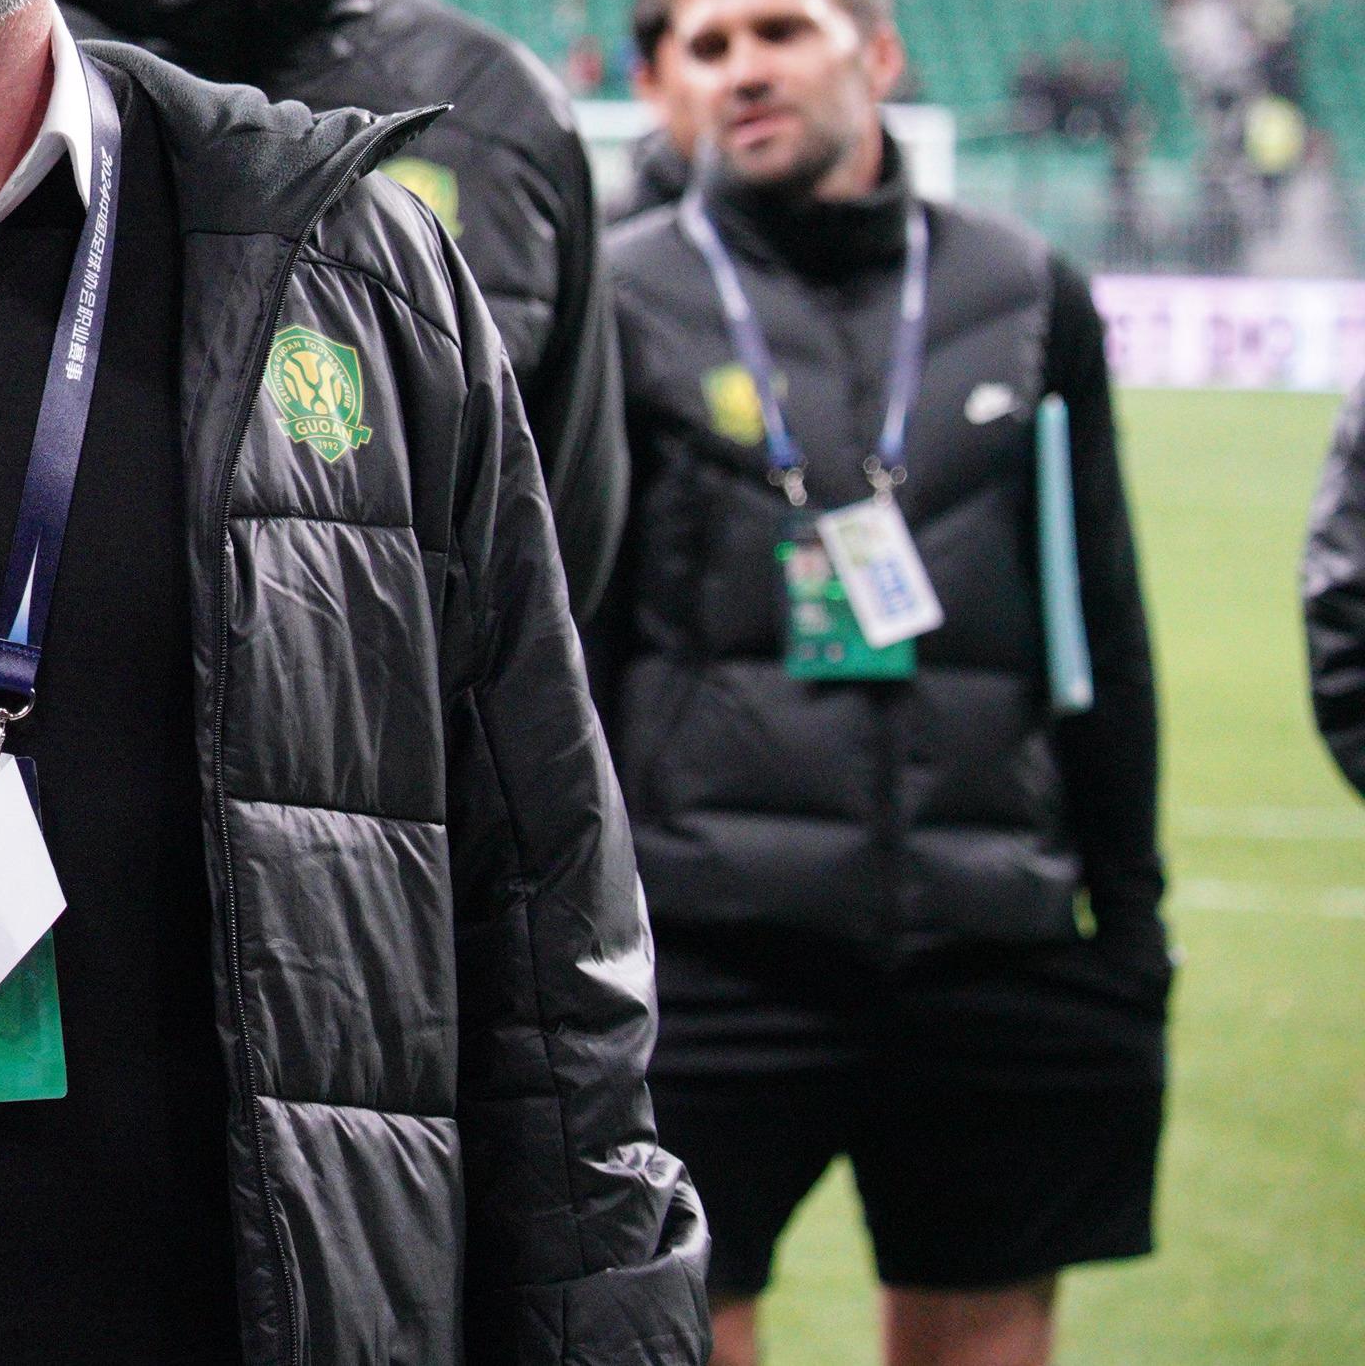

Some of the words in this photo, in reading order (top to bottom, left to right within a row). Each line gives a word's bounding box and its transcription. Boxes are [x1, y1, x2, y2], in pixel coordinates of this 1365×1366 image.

[66, 145, 113, 382] 2024中国足球协会职业赛事
[295, 420, 353, 443] GUOAN
[317, 441, 339, 452] 1992
